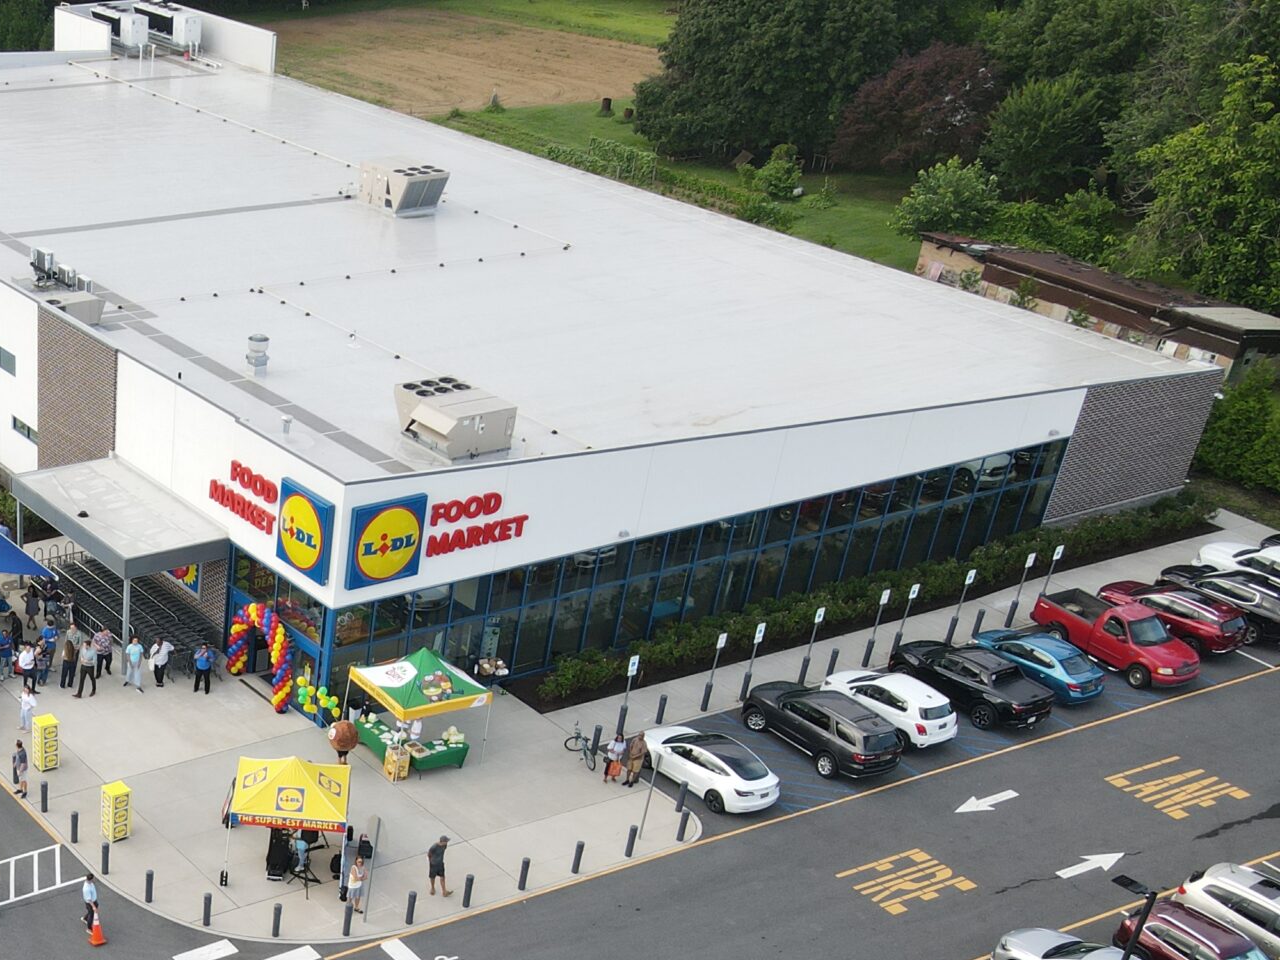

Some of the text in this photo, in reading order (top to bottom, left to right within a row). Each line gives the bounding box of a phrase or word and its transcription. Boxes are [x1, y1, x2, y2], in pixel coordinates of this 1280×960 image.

[230, 459, 278, 505] FOOD
[208, 479, 276, 536] MARKET
[430, 491, 503, 528] FOOD
[426, 514, 529, 558] MARKET
[1104, 755, 1251, 820] LANE
[237, 814, 339, 831] THE SUPER-EST MARKET
[834, 848, 978, 916] FIRE
